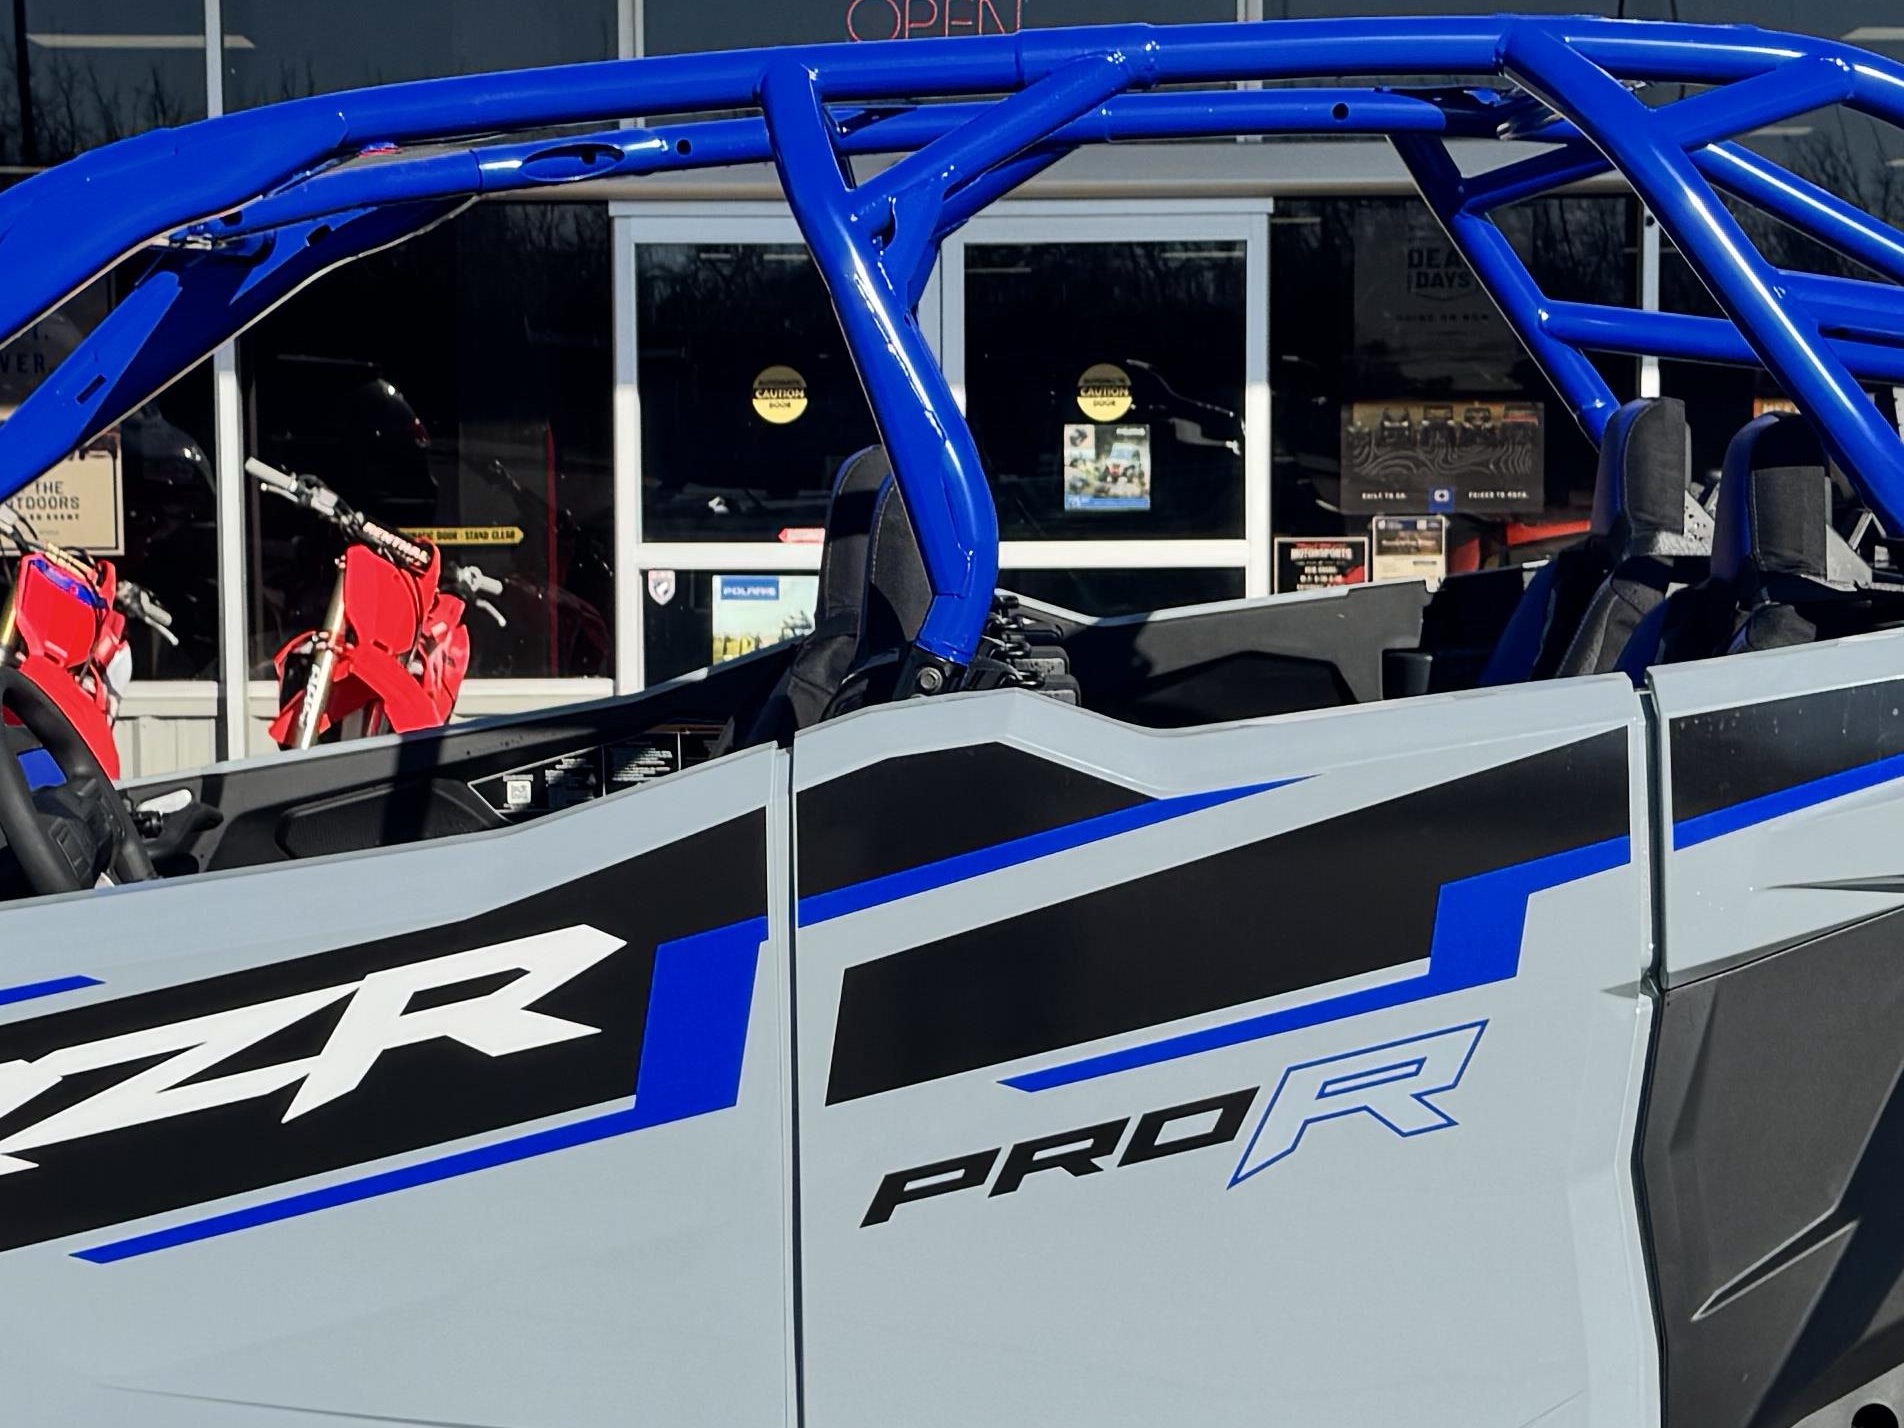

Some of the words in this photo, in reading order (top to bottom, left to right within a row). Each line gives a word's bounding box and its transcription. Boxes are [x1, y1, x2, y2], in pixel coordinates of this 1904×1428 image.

[1408, 249, 1462, 268] DEA
[1416, 271, 1471, 288] DAYS
[754, 387, 805, 399] CAUTION
[1080, 386, 1130, 398] CAUTION
[35, 480, 65, 495] THE
[465, 530, 489, 540] STAND
[491, 530, 516, 540] CLEAR
[858, 1085, 1261, 1228] PRO
[1226, 1018, 1490, 1190] R
